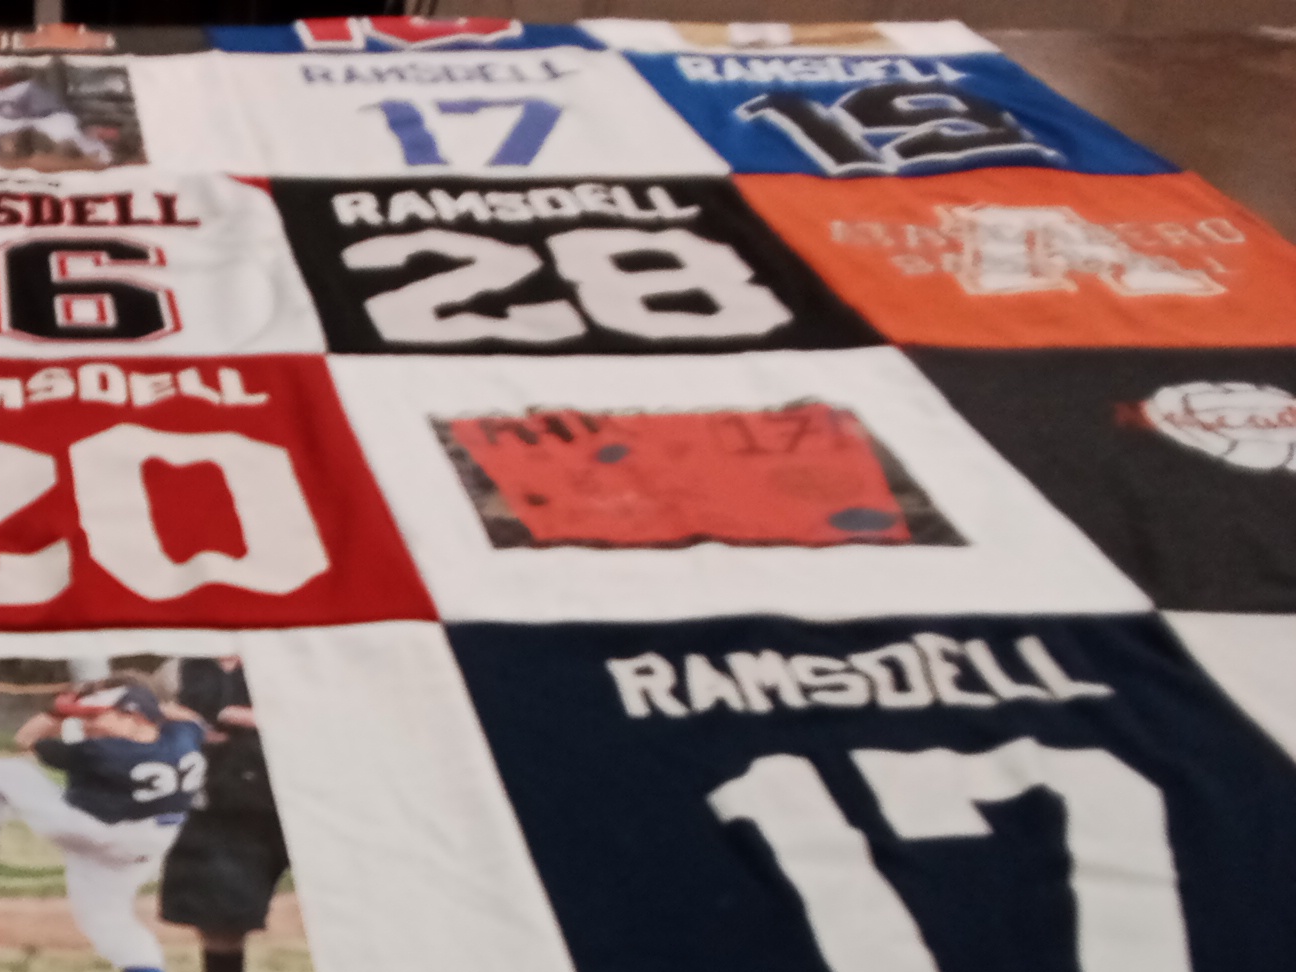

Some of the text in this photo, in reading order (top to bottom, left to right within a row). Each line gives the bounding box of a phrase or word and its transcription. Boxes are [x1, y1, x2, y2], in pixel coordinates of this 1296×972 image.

[359, 98, 562, 166] 17
[332, 183, 701, 226] RAMSDELL
[340, 227, 795, 343] 28
[606, 631, 1115, 718] RAMSDELL
